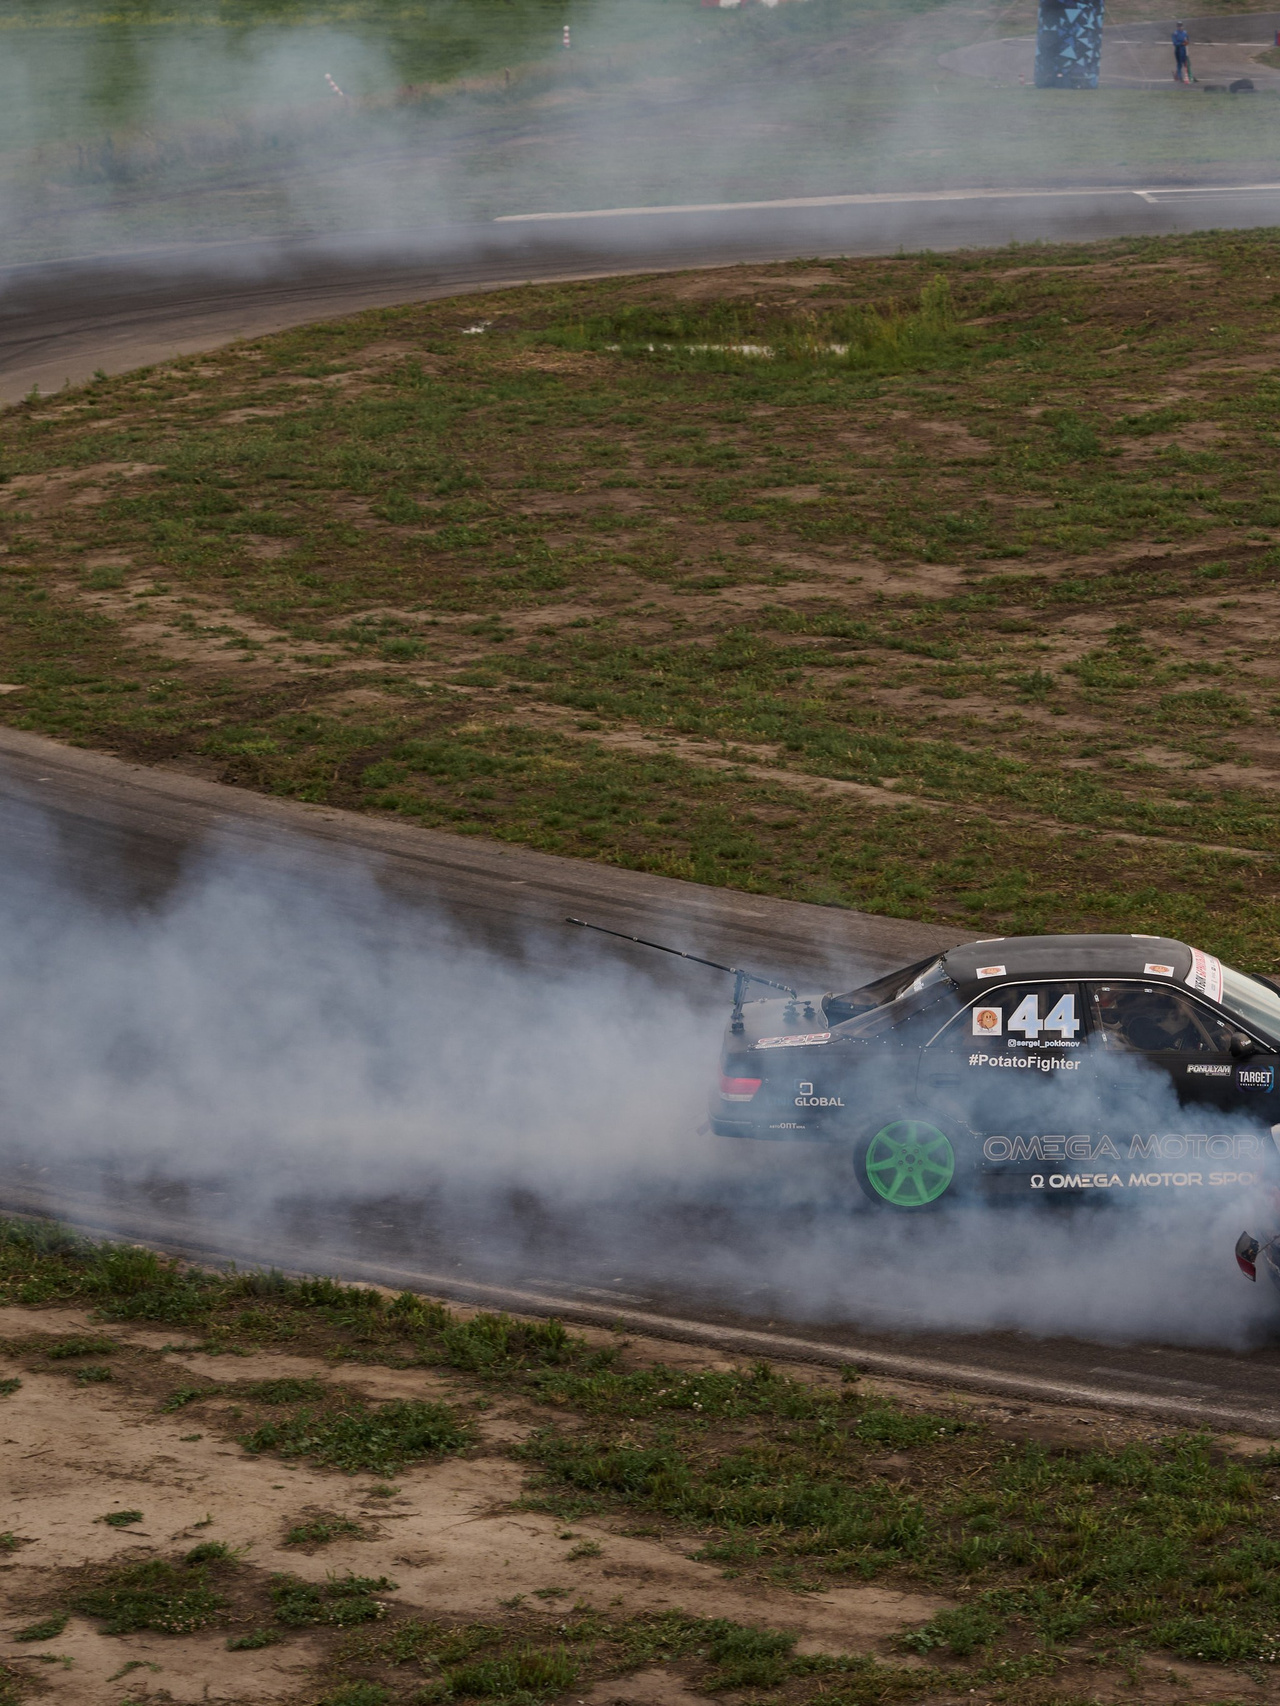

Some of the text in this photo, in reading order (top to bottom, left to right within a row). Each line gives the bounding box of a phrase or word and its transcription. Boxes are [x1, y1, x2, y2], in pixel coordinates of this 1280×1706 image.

[1007, 994, 1080, 1039] 44
[968, 1054, 1081, 1072] #PotatoFighter
[1239, 1071, 1272, 1083] TARGET
[794, 1097, 845, 1107] GLOBAL
[983, 1134, 1121, 1161] OMEGA
[1048, 1173, 1124, 1189] OMEGA
[1128, 1173, 1203, 1187] MOTOR
